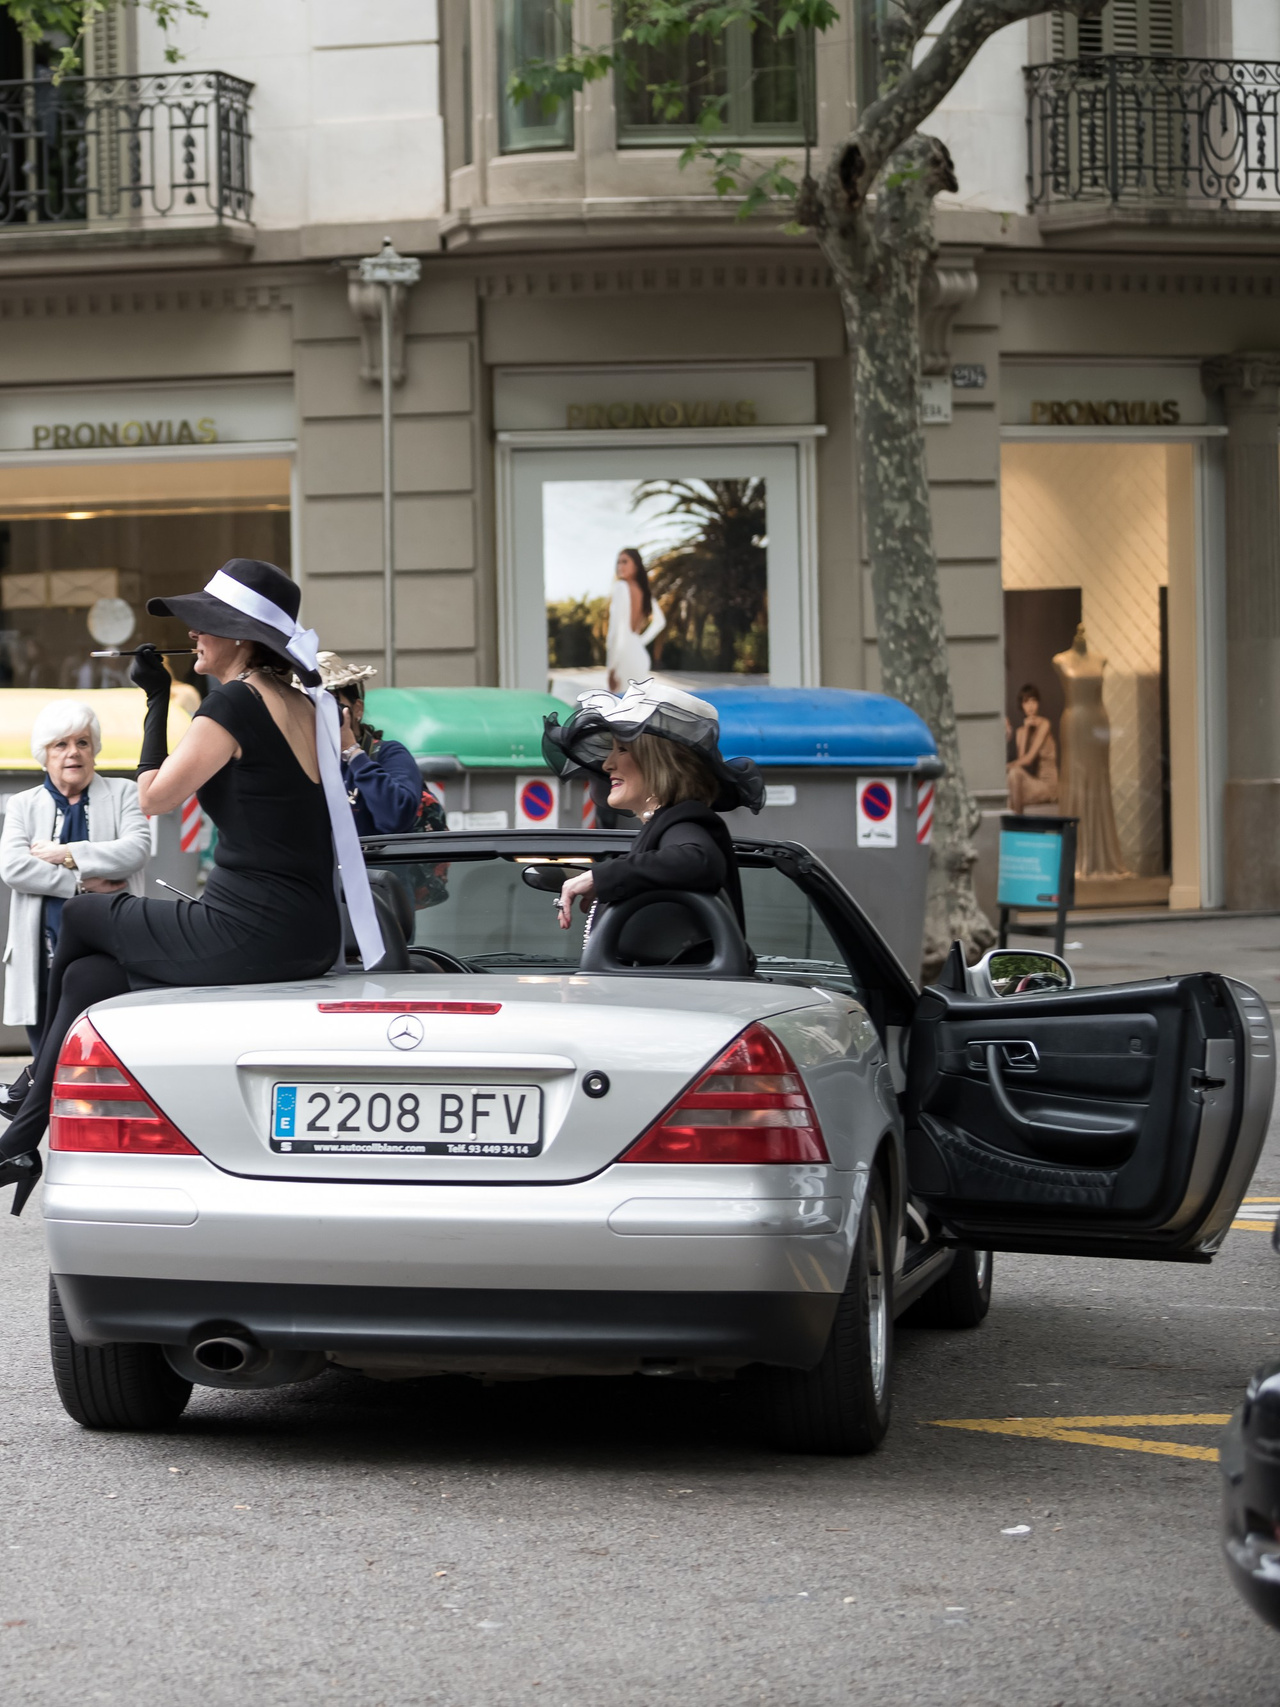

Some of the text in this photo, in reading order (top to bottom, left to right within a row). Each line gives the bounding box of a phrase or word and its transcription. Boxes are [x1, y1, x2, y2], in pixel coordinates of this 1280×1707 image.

[566, 401, 757, 429] PRONOVIAS
[1030, 399, 1180, 425] PRONOVIAS
[32, 417, 219, 450] PRONOVIAS
[280, 1117, 291, 1130] E
[307, 1092, 526, 1135] 2208 BFV
[447, 1144, 529, 1155] Telf. 93 449 34 14
